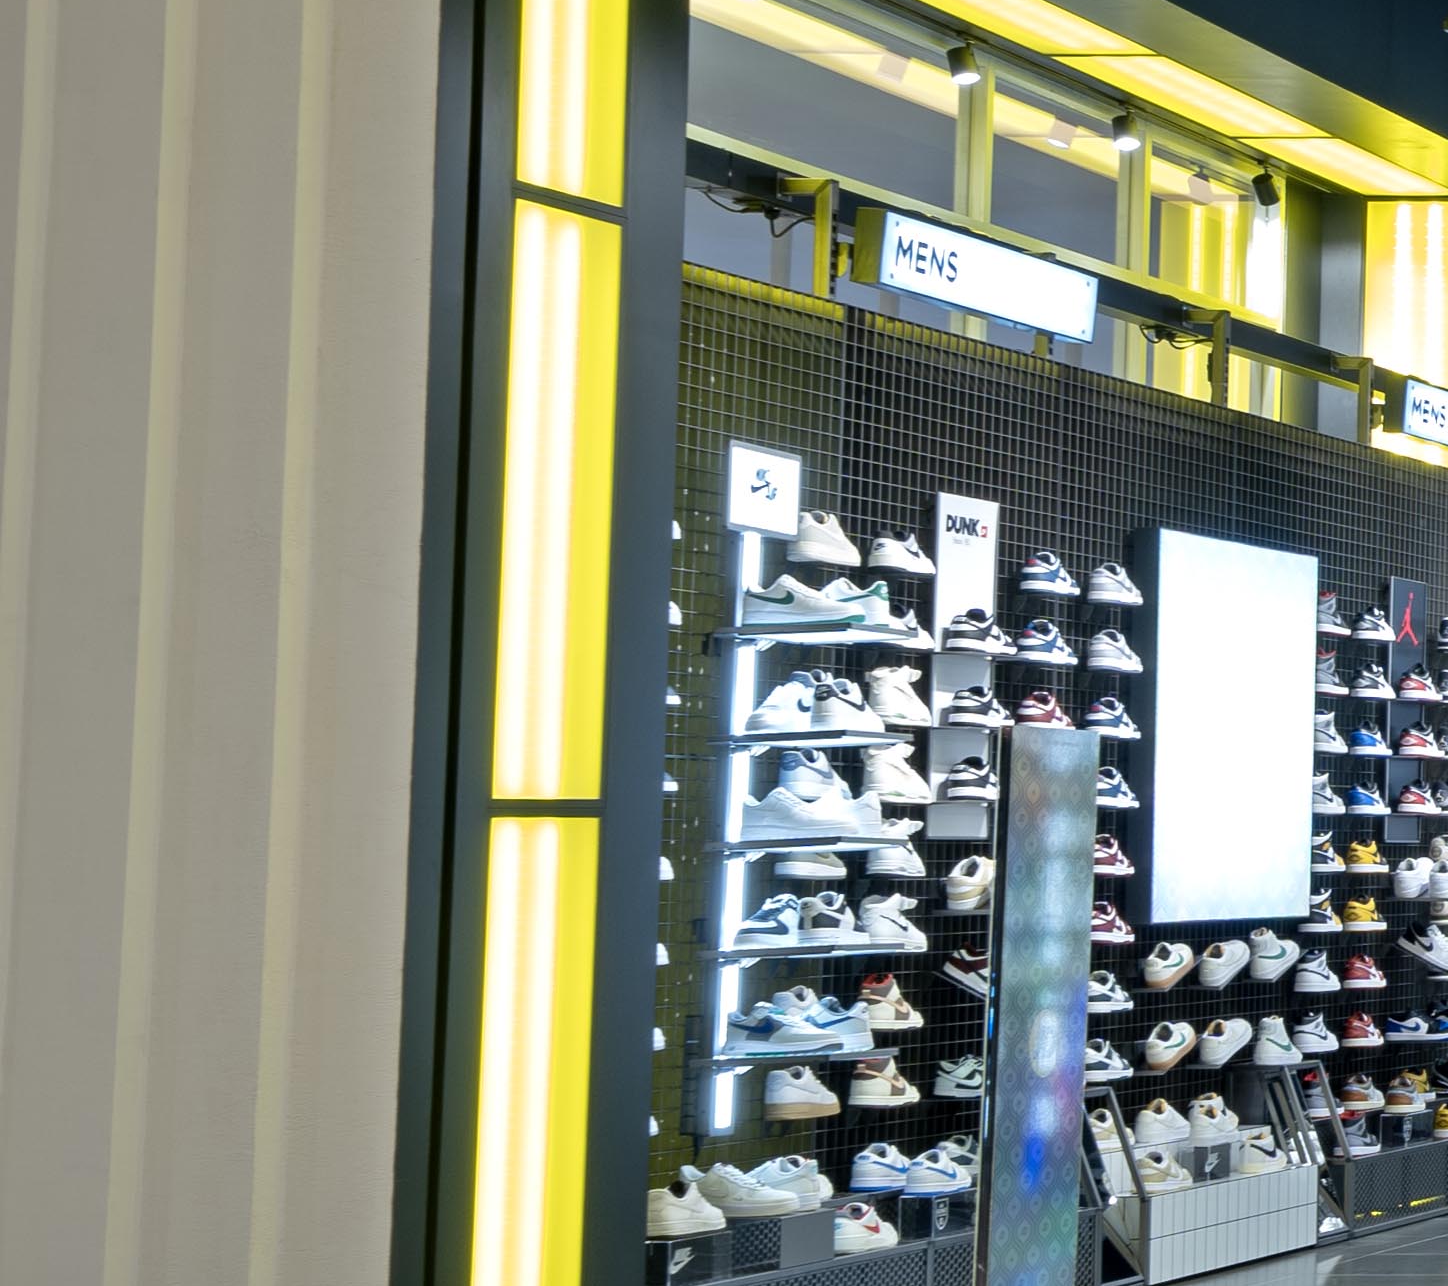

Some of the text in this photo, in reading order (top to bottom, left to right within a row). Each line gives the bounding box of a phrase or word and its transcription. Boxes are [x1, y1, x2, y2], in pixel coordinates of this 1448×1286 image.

[895, 236, 958, 282] MENS
[1411, 397, 1446, 428] MENS
[946, 514, 980, 537] DUNK
